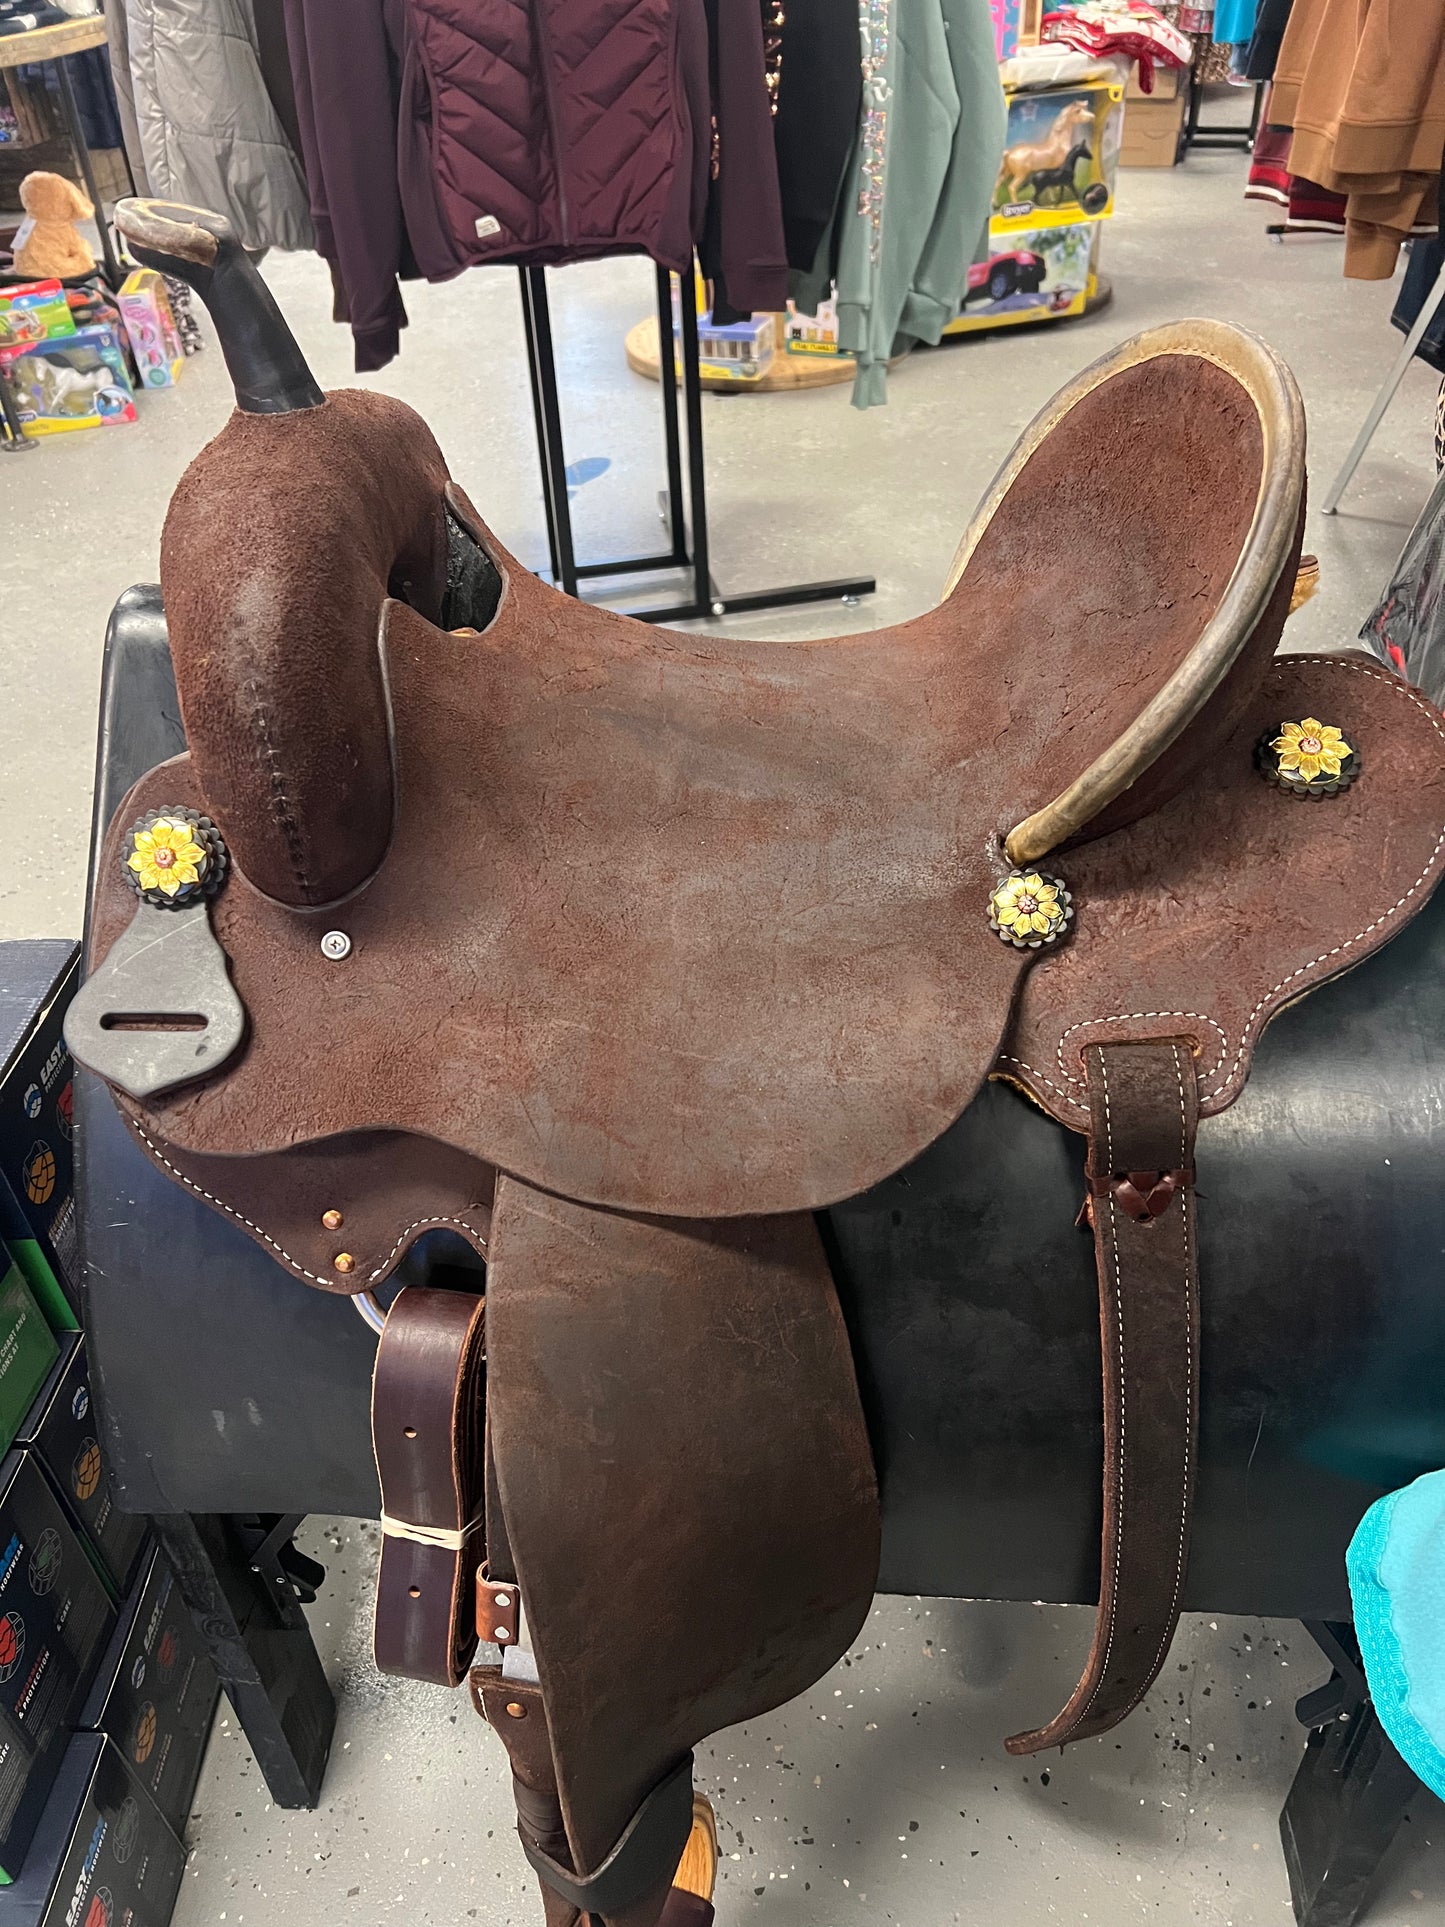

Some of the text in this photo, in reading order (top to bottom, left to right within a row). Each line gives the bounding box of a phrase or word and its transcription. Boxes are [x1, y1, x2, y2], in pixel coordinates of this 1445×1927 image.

[45, 1054, 67, 1094] PROTECTIVE
[0, 1312, 27, 1358] CHART AND
[11, 1342, 19, 1355] AT
[0, 1543, 24, 1592] HOOFWEAR
[22, 1650, 50, 1710] PROTECTION
